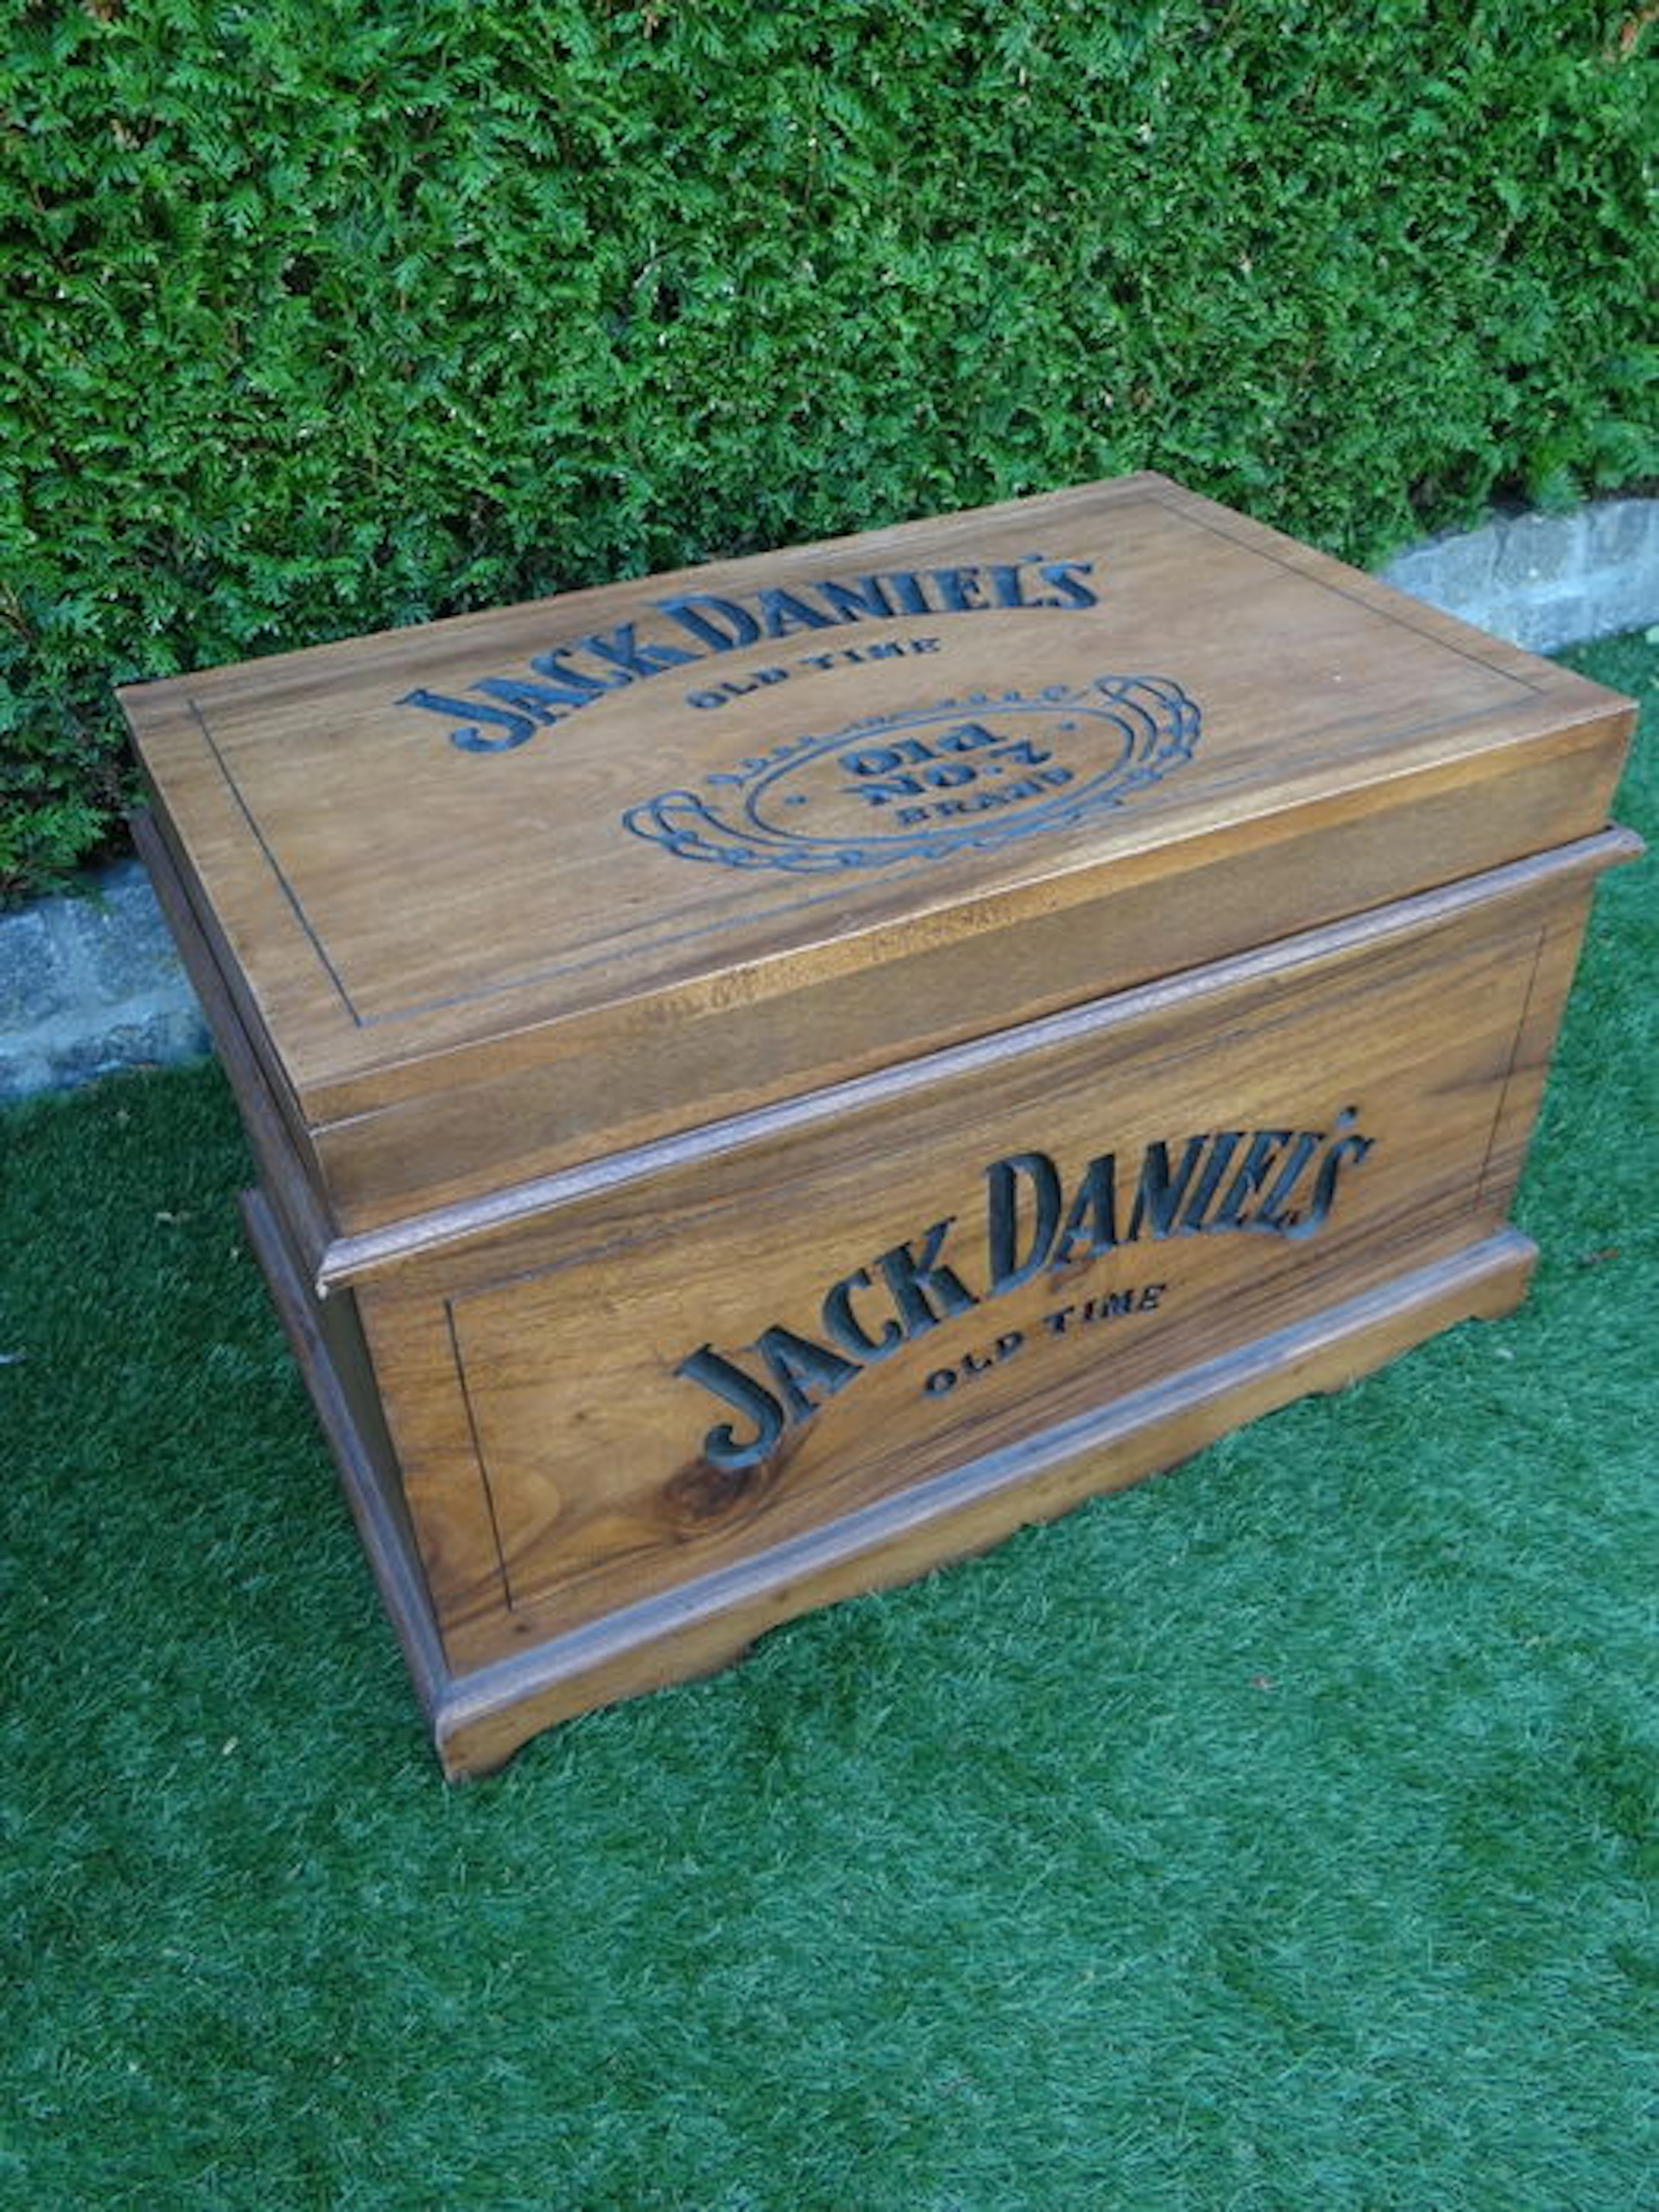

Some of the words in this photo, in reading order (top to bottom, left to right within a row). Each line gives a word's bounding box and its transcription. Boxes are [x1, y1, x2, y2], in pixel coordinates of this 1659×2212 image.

[394, 621, 705, 753] JACK
[652, 554, 1100, 652] DANIEL'S
[685, 666, 789, 709] OLD
[797, 637, 941, 670] TIME
[895, 766, 1073, 826] BRAND
[672, 1215, 982, 1468] JACK
[984, 1104, 1376, 1298] DANIEL'S
[923, 1330, 1026, 1397] OLD
[1042, 1283, 1167, 1335] TIME
